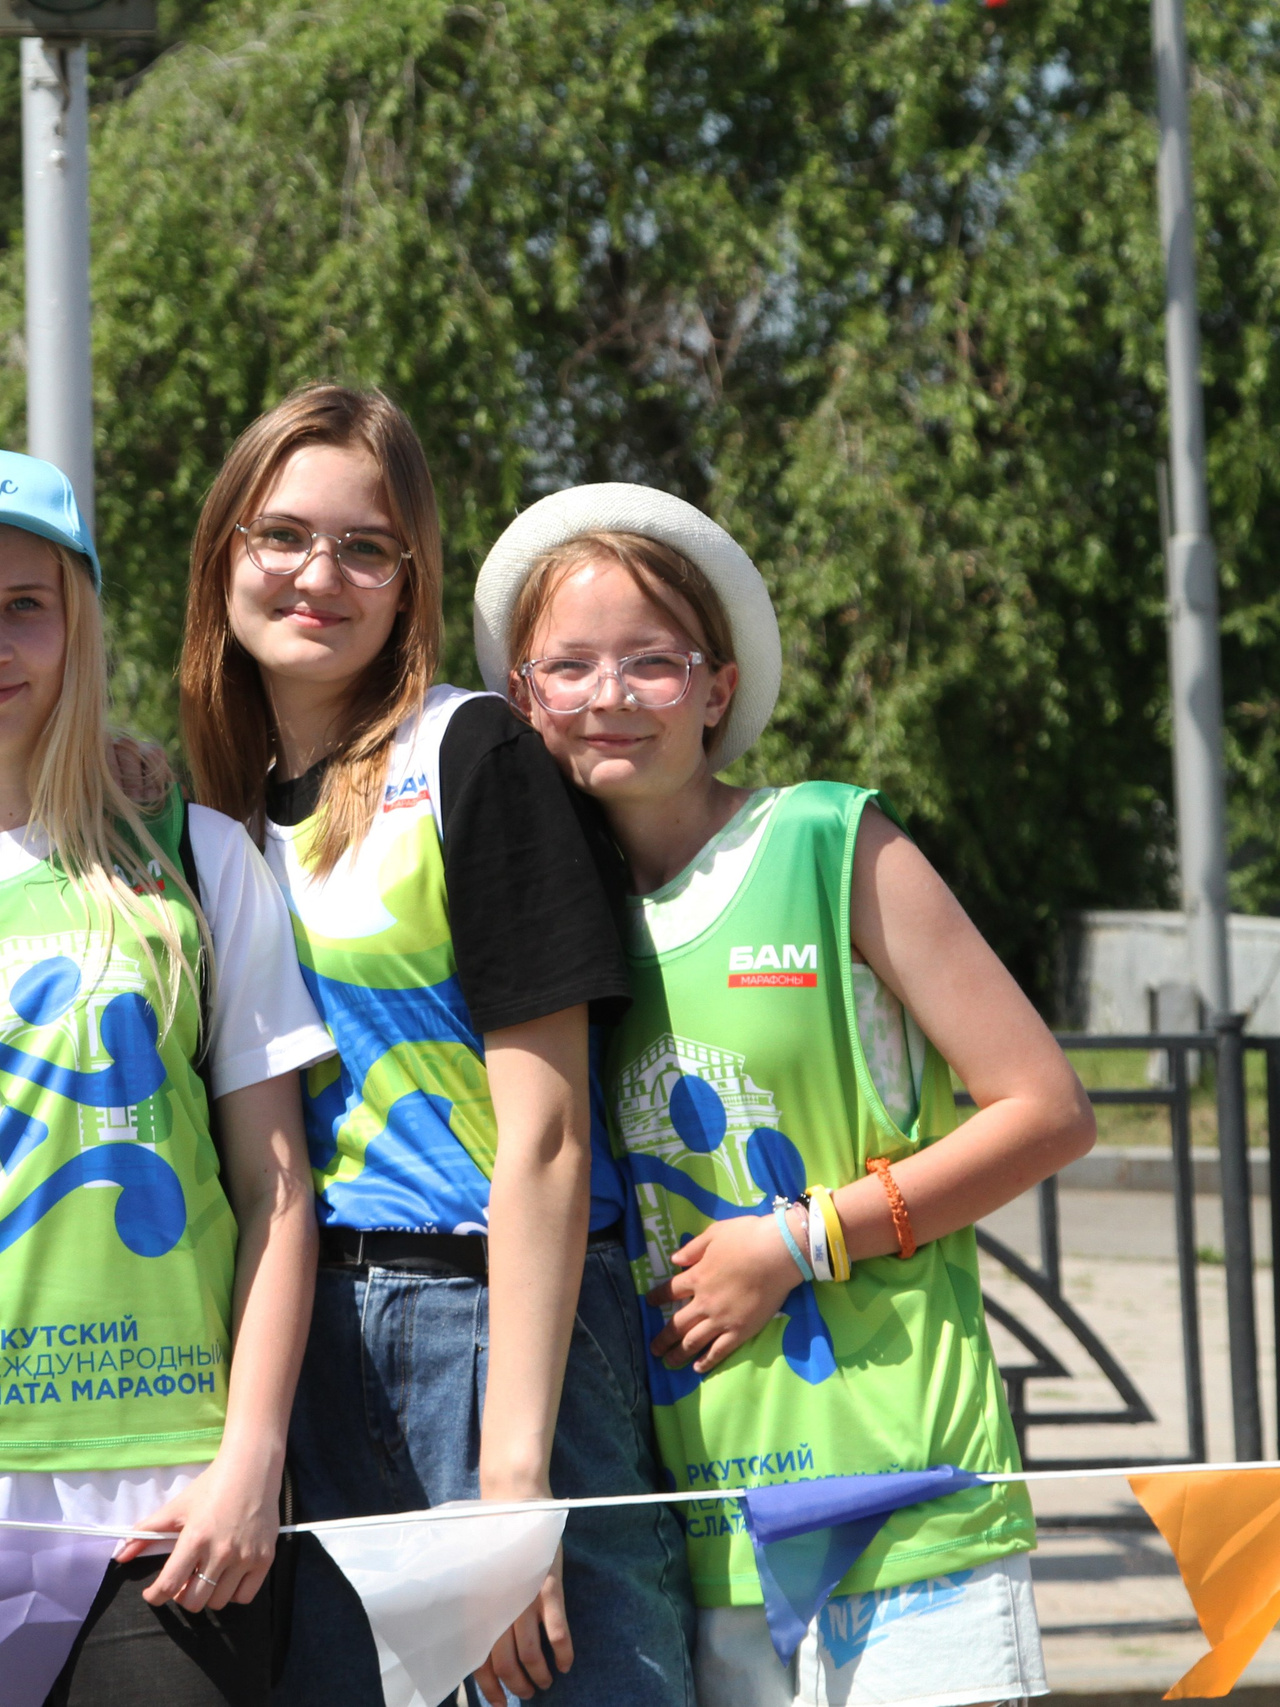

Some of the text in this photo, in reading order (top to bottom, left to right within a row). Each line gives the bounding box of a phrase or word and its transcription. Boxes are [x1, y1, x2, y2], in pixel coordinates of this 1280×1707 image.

[729, 944, 817, 971] БАМ
[741, 974, 804, 985] МАРАФОНЫ
[72, 1372, 215, 1402] МАРАФОН
